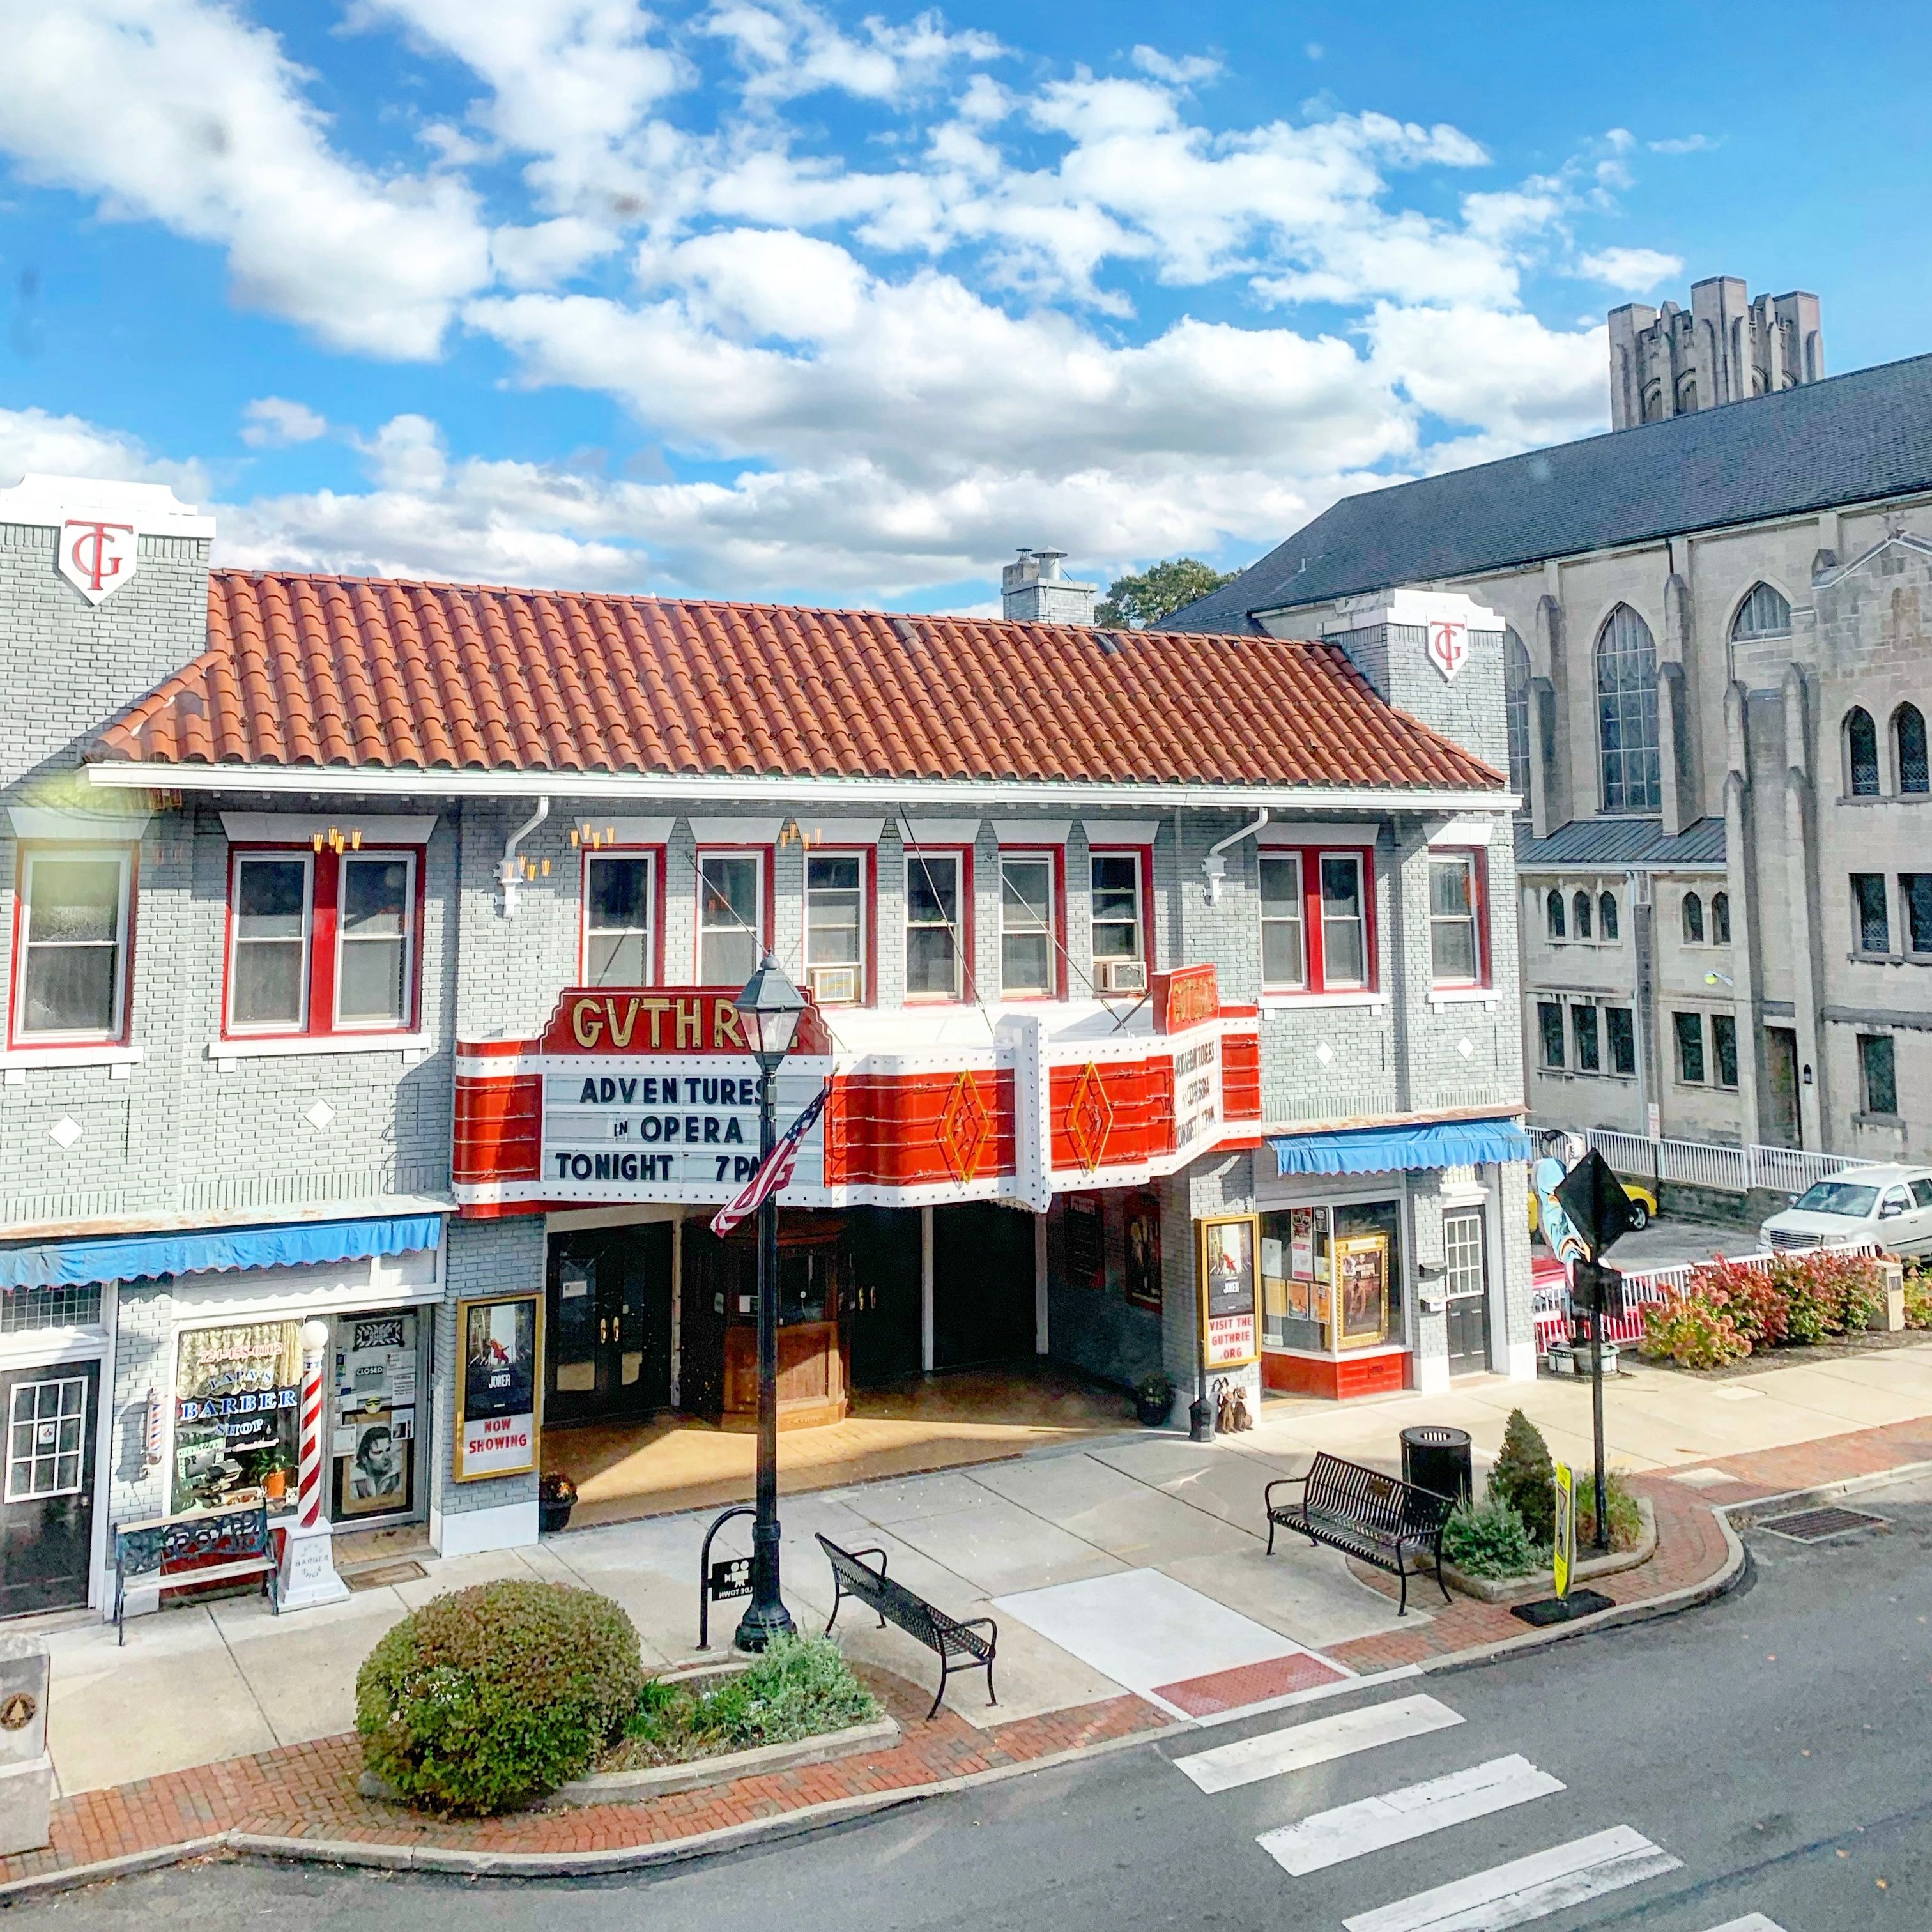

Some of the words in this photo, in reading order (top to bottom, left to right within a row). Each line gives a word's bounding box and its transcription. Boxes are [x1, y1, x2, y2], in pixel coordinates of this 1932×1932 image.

[614, 1120, 628, 1137] IN
[641, 1116, 743, 1144] OPERA
[555, 1153, 674, 1181] TONIGHT
[716, 1155, 730, 1182] 7
[1223, 1282, 1240, 1294] JOKER
[1209, 1319, 1233, 1331] VISIT
[1236, 1316, 1253, 1328] THE
[1212, 1331, 1250, 1346] GUTHRIE
[200, 1342, 283, 1364] 724-458-0102
[356, 1366, 383, 1376] CLOSED
[488, 1374, 511, 1389] JOKER
[180, 1390, 298, 1422] BARBER
[215, 1418, 264, 1437] SHOP
[484, 1418, 512, 1434] NOW
[469, 1434, 527, 1454] SHOWING
[295, 1554, 329, 1567] BARBER
